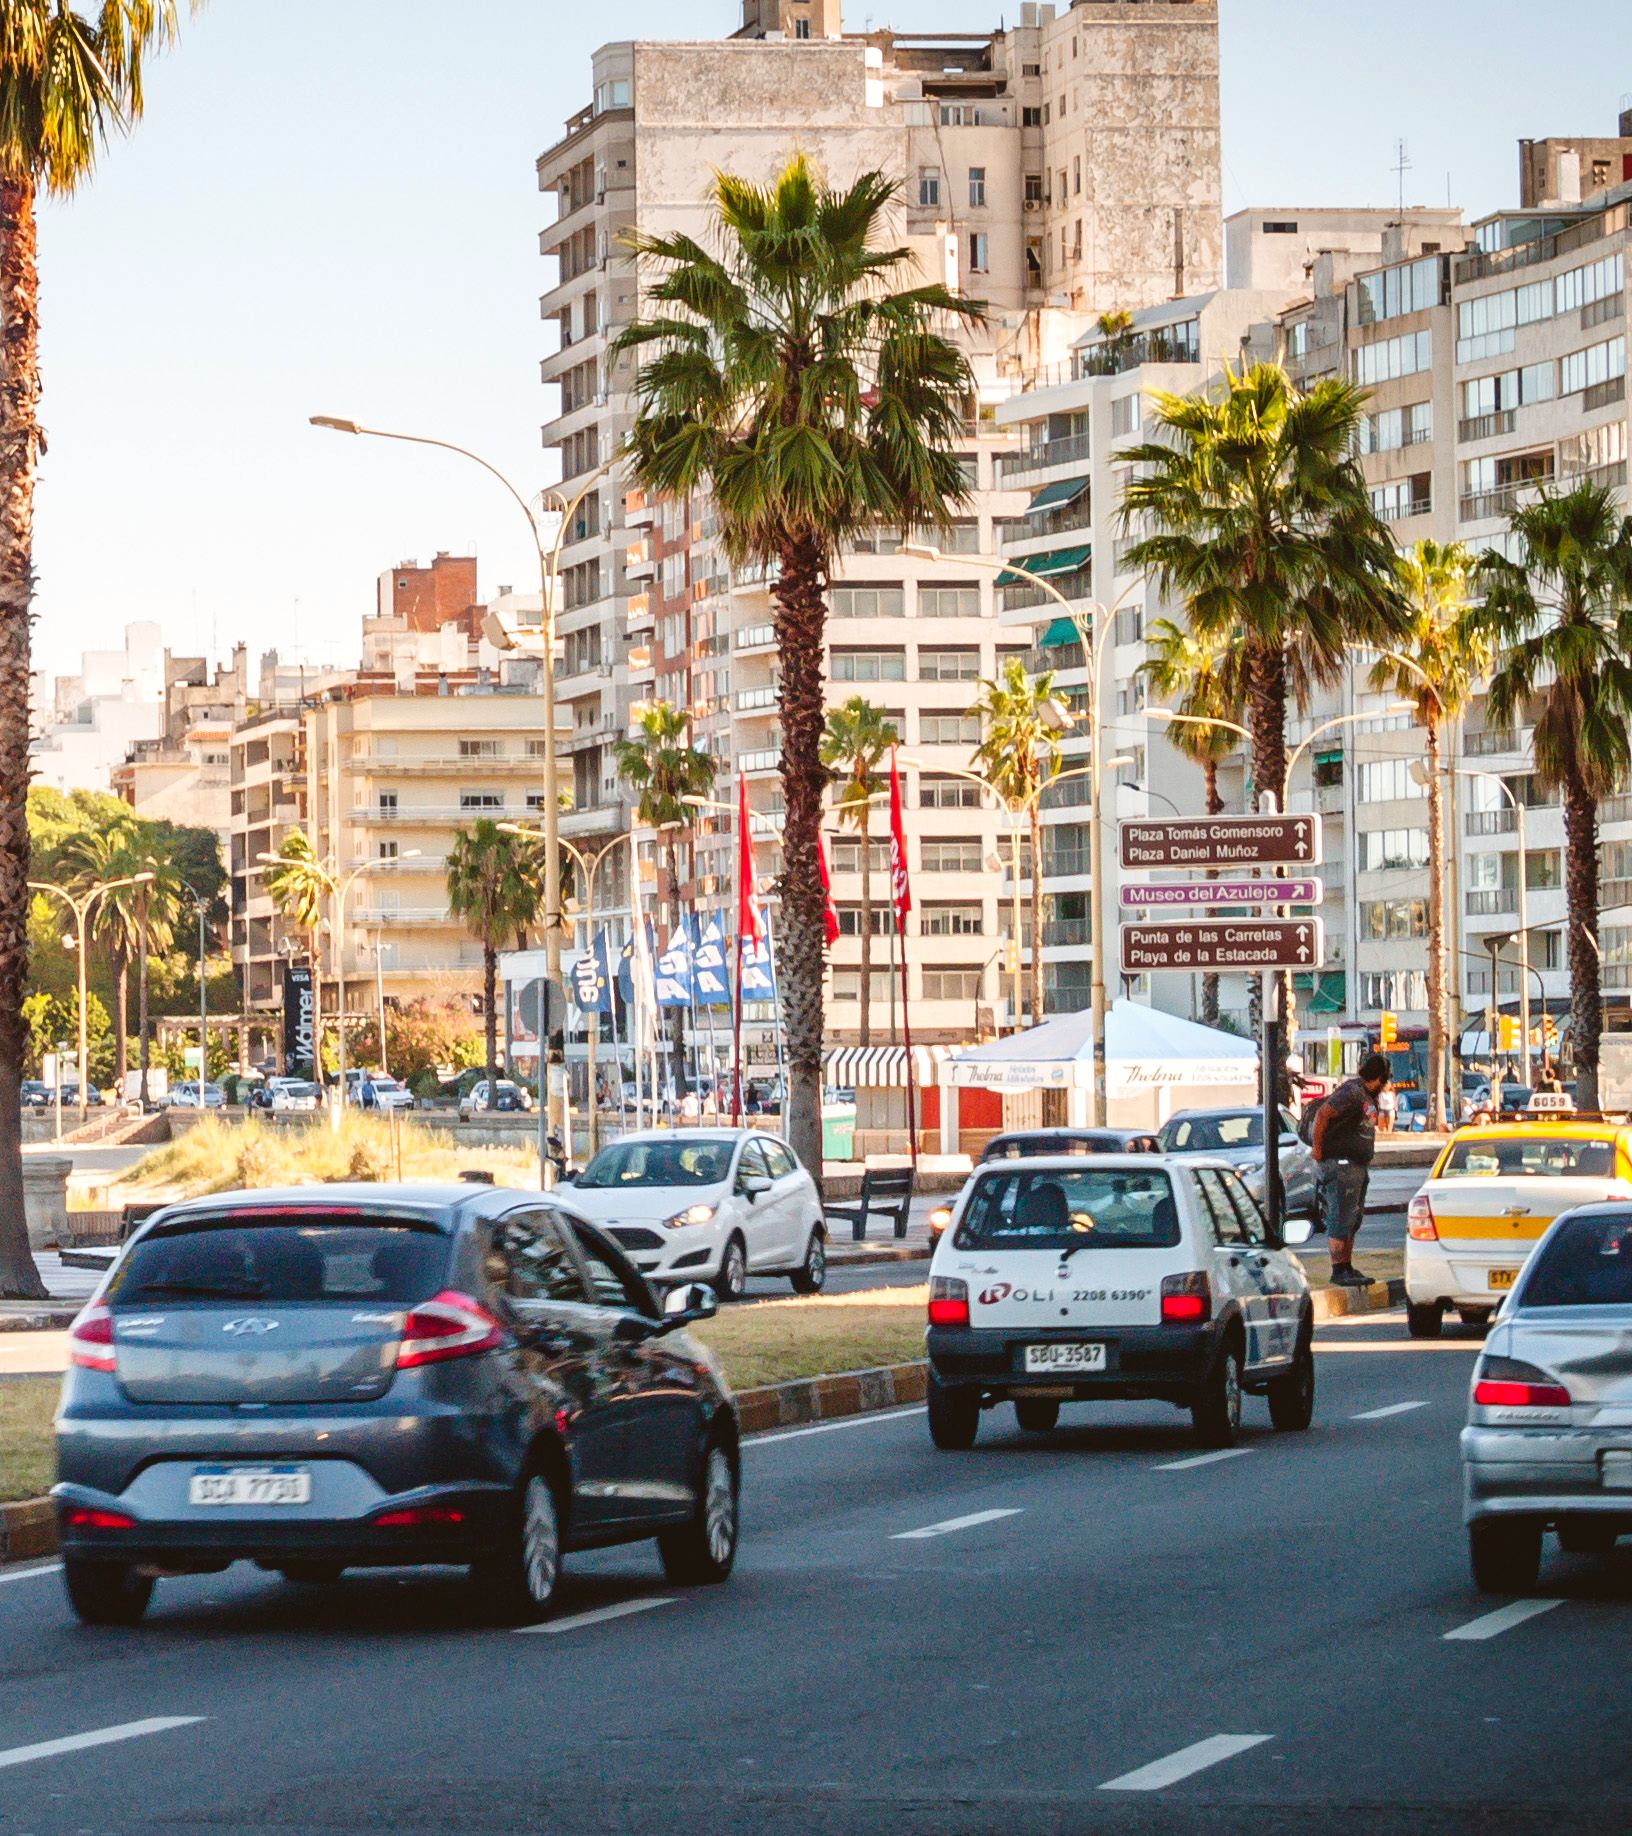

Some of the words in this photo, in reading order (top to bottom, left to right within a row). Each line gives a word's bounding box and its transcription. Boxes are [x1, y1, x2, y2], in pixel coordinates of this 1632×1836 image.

[1129, 828, 1164, 841] Plaza
[1166, 825, 1207, 840] Tomás
[1210, 825, 1284, 840] Gomensoro
[1129, 847, 1164, 861] Plaza
[1170, 846, 1210, 860] Daniel
[1216, 844, 1259, 858] Muñoz
[1130, 888, 1185, 901] Museo
[1189, 886, 1213, 900] del
[1216, 885, 1279, 902] Azulejo
[1131, 931, 1169, 944] Punta
[1175, 929, 1192, 943] de
[1199, 929, 1218, 942] las
[1225, 928, 1282, 942] Carretas
[1131, 950, 1168, 966] Playa
[1174, 949, 1191, 962] de
[1197, 949, 1209, 962] la
[1216, 947, 1278, 961] Estacada
[967, 1064, 1004, 1083] Thelma
[1123, 1064, 1183, 1084] Thelma
[1533, 1093, 1566, 1107] 6059
